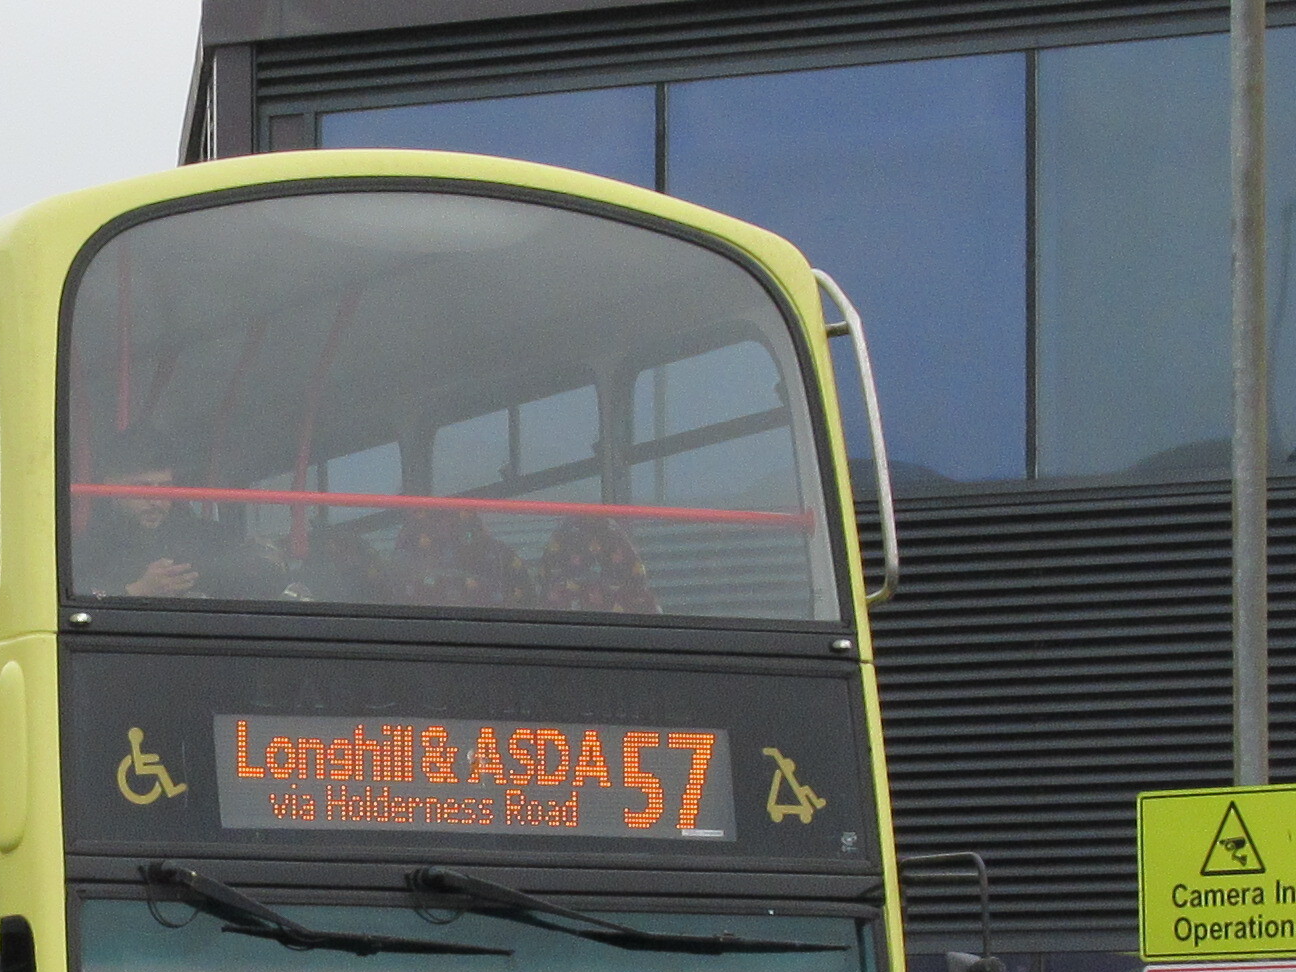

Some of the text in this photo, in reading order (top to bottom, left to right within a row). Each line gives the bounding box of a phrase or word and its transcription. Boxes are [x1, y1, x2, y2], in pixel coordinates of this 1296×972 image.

[236, 719, 613, 788] Longhill & ASDA
[622, 731, 717, 830] 57
[268, 783, 580, 828] via Holderness Road
[1171, 879, 1296, 909] Camera In
[1173, 913, 1295, 948] Operation
